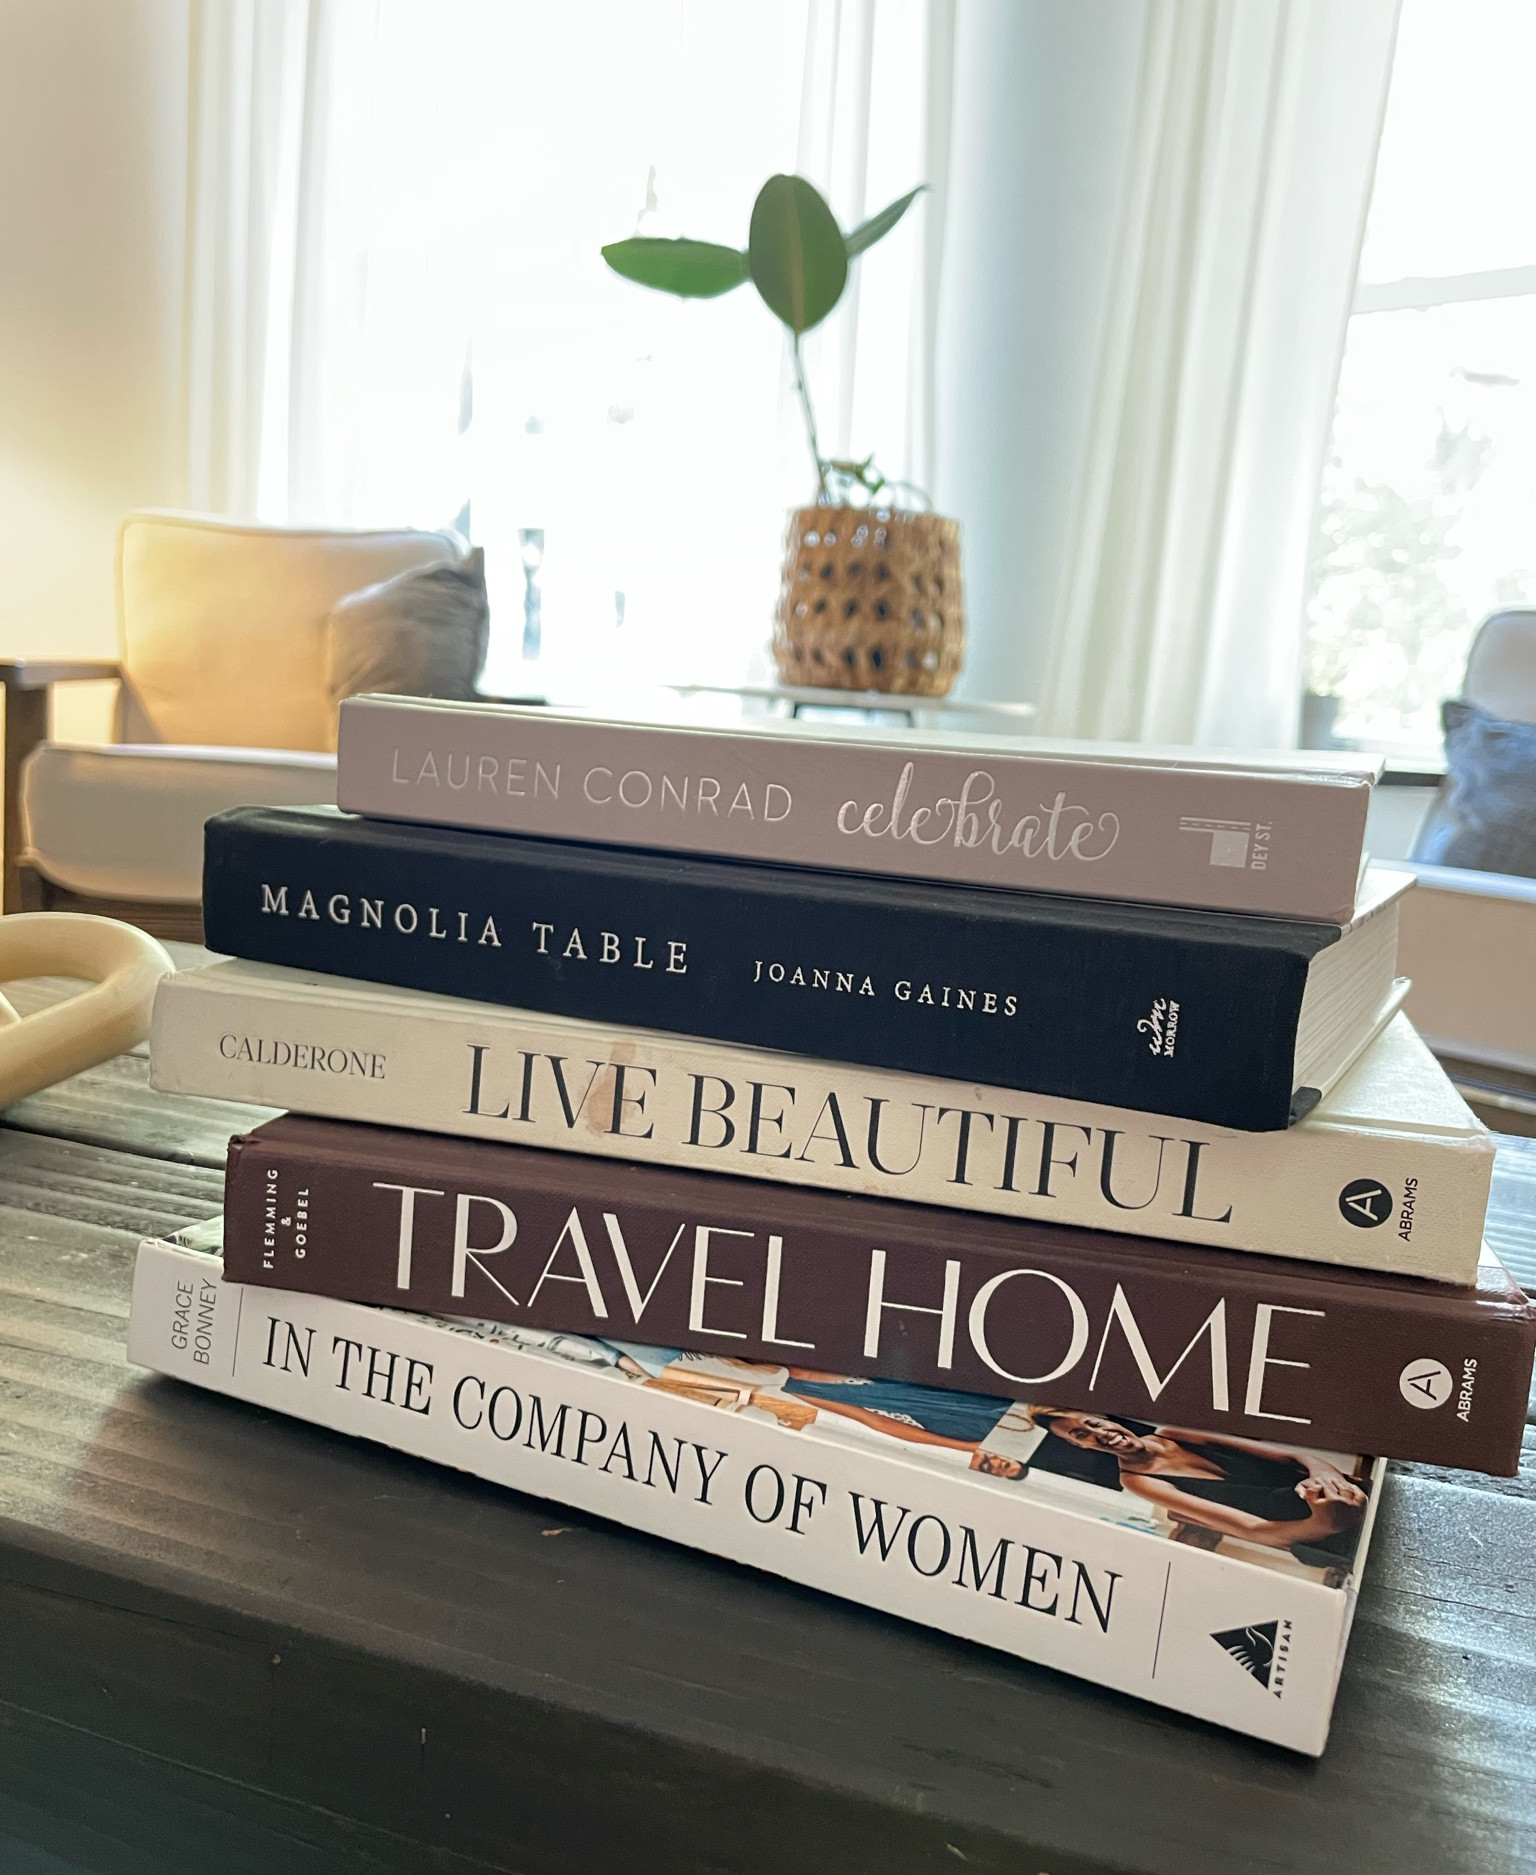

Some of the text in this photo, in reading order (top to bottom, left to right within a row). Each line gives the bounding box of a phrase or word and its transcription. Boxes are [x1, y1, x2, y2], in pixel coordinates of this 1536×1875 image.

[392, 746, 793, 823] LAUREN CONRAD
[837, 761, 1120, 862] celebrate
[1250, 820, 1273, 870] DEY ST.
[260, 883, 688, 975] MAGNOLIA TABLE
[753, 960, 1018, 1017] JOANNA GAINES
[218, 1033, 387, 1080] CALDERONE
[1163, 999, 1180, 1058] MORROW
[461, 1043, 1234, 1224] LIVE BEAUTIFUL
[262, 1168, 279, 1270] FLEMMING
[280, 1215, 293, 1227] &
[294, 1187, 310, 1260] GOEBEL
[1398, 1176, 1419, 1242] ABRAMS
[170, 1280, 195, 1351] GRACE
[192, 1277, 218, 1366] BONNEY
[372, 1181, 1326, 1425] TRAVEL HOME
[1456, 1357, 1479, 1423] ABRAMS
[261, 1315, 1124, 1635] IN THE COMPANY OF WOMEN
[1272, 1618, 1294, 1701] ARTISAN
